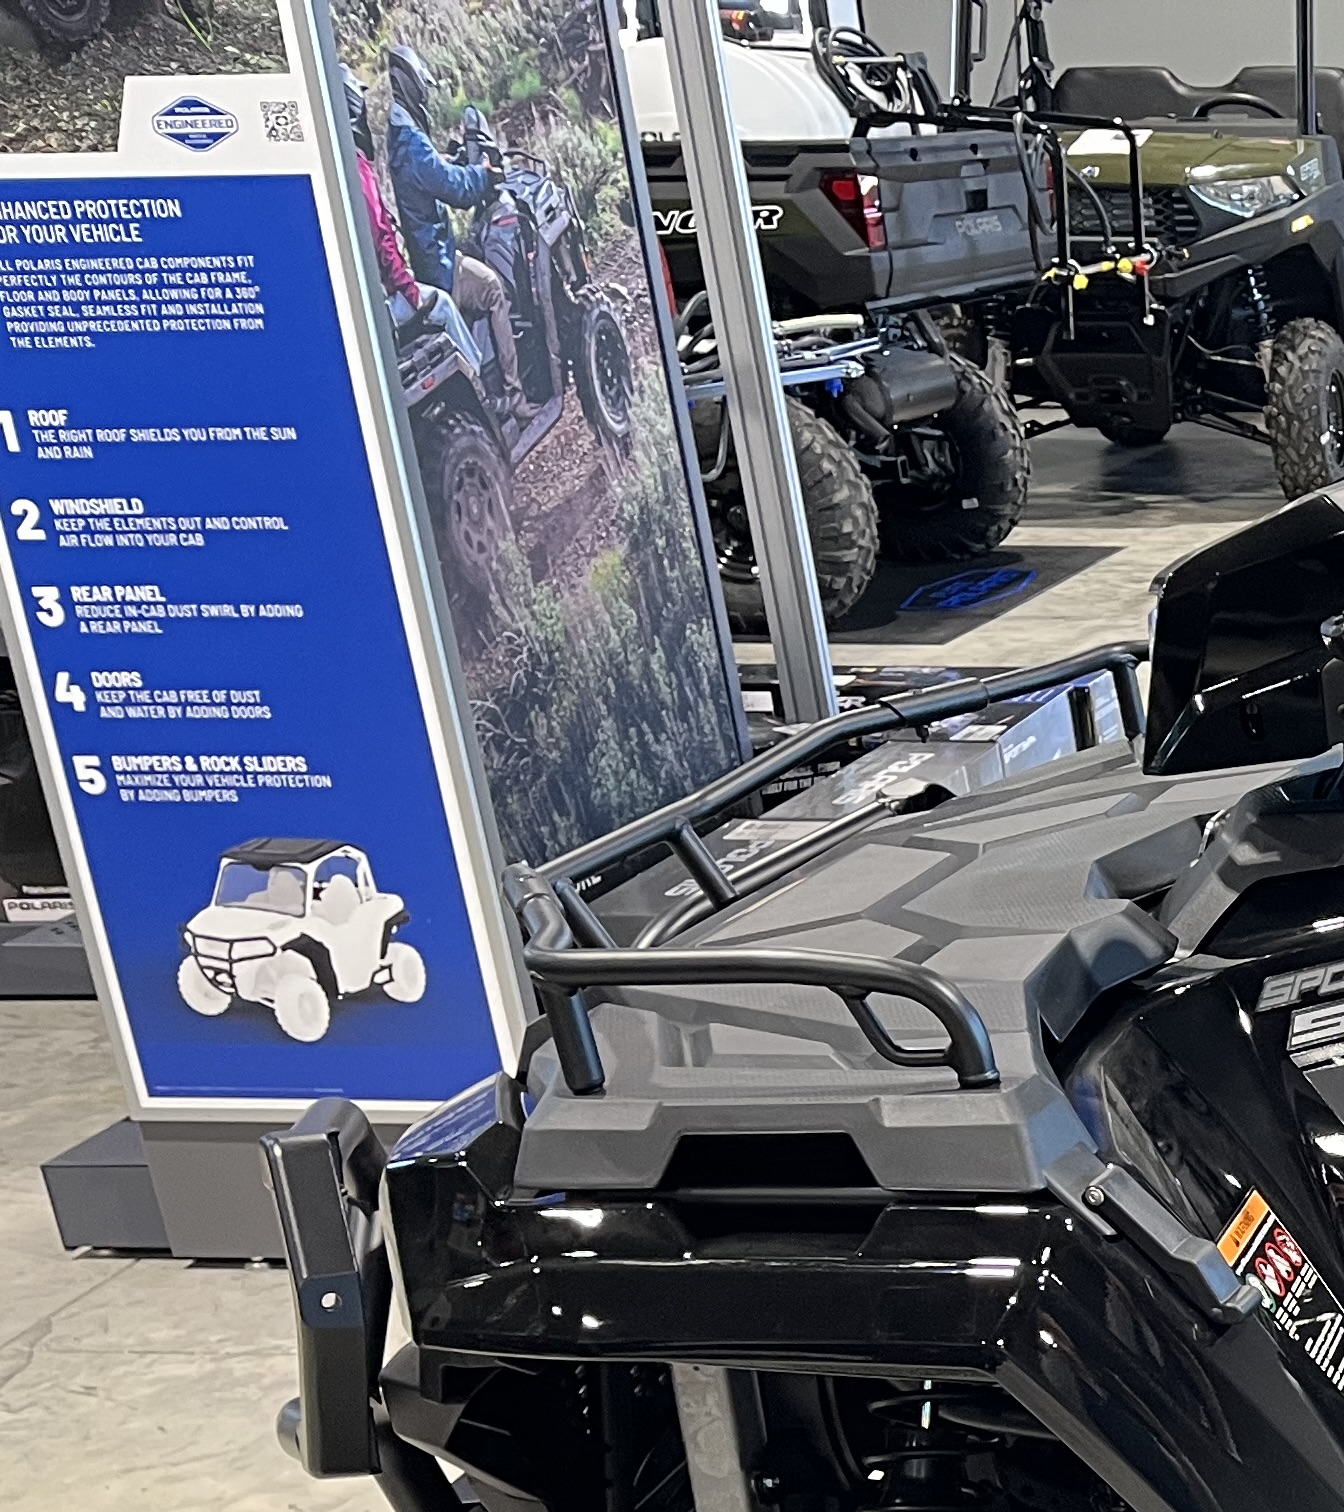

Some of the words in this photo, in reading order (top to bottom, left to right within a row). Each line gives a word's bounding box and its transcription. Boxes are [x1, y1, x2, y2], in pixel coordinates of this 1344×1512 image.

[156, 119, 234, 130] ENGINEERED
[75, 199, 182, 220] PROTECTION
[20, 225, 69, 244] YOUR
[70, 223, 143, 243] VEHICLE
[15, 258, 62, 271] POLARIS
[64, 257, 134, 270] ENGINEERED
[136, 257, 159, 270] CAB
[160, 256, 235, 269] COMPONENTS
[236, 255, 255, 268] FIT
[60, 274, 82, 286] THE
[84, 273, 142, 286] CONTOURS
[144, 273, 159, 285] OF
[161, 272, 184, 285] THE
[185, 272, 209, 284] CAB
[0, 290, 36, 303] FLOOR
[38, 290, 61, 302] AND
[62, 289, 91, 302] BODY
[141, 288, 199, 301] ALLOWING
[200, 287, 222, 300] FOR
[225, 288, 234, 300] A
[2, 305, 44, 318] GASKET
[81, 304, 138, 317] SEAMLESS
[140, 304, 158, 316] FIT
[161, 303, 184, 316] AND
[185, 303, 265, 315] INSTALLATION
[6, 321, 64, 333] PROVIDING
[66, 319, 160, 333] UNPRECEDENTED
[162, 319, 231, 332] PROTECTION
[233, 318, 264, 331] FROM
[9, 336, 32, 349] THE
[0, 410, 21, 453] 1
[27, 409, 68, 427] ROOF
[32, 429, 58, 443] THE
[59, 429, 95, 443] RIGHT
[96, 428, 126, 442] ROOF
[130, 428, 181, 442] SHIELDS
[182, 427, 207, 441] YOU
[208, 427, 243, 441] FROM
[244, 427, 268, 441] THE
[270, 426, 297, 441] SUN
[37, 446, 62, 459] AND
[63, 445, 94, 459] RAIN
[10, 498, 47, 541] 2
[49, 498, 145, 515] WINDSHIELD
[54, 518, 86, 532] KEEP
[88, 518, 111, 531] THE
[113, 517, 177, 531] ELEMENTS
[178, 517, 202, 530] OUT
[205, 517, 230, 530] AND
[231, 516, 289, 530] CONTROL
[59, 534, 79, 547] AIR
[81, 534, 114, 547] FLOW
[116, 534, 145, 547] INTO
[145, 533, 178, 547] YOUR
[179, 533, 205, 546] CAB
[31, 586, 66, 628] 3
[70, 585, 113, 602] REAR
[115, 585, 166, 602] PANEL
[75, 605, 123, 618] REDUCE
[124, 604, 166, 618] IN-CAB
[167, 604, 198, 618] DUST
[200, 604, 239, 618] SWIRL
[240, 604, 258, 617] BY
[258, 604, 304, 618] ADDING
[79, 621, 90, 634] A
[91, 621, 122, 634] REAR
[123, 621, 163, 634] PANEL
[55, 671, 87, 712] 4
[90, 671, 143, 688] DOORS
[95, 690, 126, 703] KEEP
[129, 690, 151, 703] THE
[153, 690, 178, 703] CAB
[180, 690, 211, 703] FREE
[212, 690, 228, 703] OF
[230, 690, 261, 703] DUST
[100, 706, 124, 719] AND
[126, 706, 166, 719] WATER
[167, 706, 185, 719] BY
[186, 706, 229, 719] ADDING
[231, 705, 272, 719] DOORS
[71, 755, 107, 796] 5
[111, 755, 183, 772] BUMPERS
[184, 755, 199, 772] &
[199, 755, 244, 772] ROCK
[244, 756, 308, 772] SLIDERS
[115, 774, 172, 787] MAXIMIZE
[172, 774, 204, 787] YOUR
[205, 774, 257, 788] VEHICLE
[258, 775, 332, 788] PROTECTION
[120, 790, 135, 802] BY
[183, 790, 239, 803] BUMPERS
